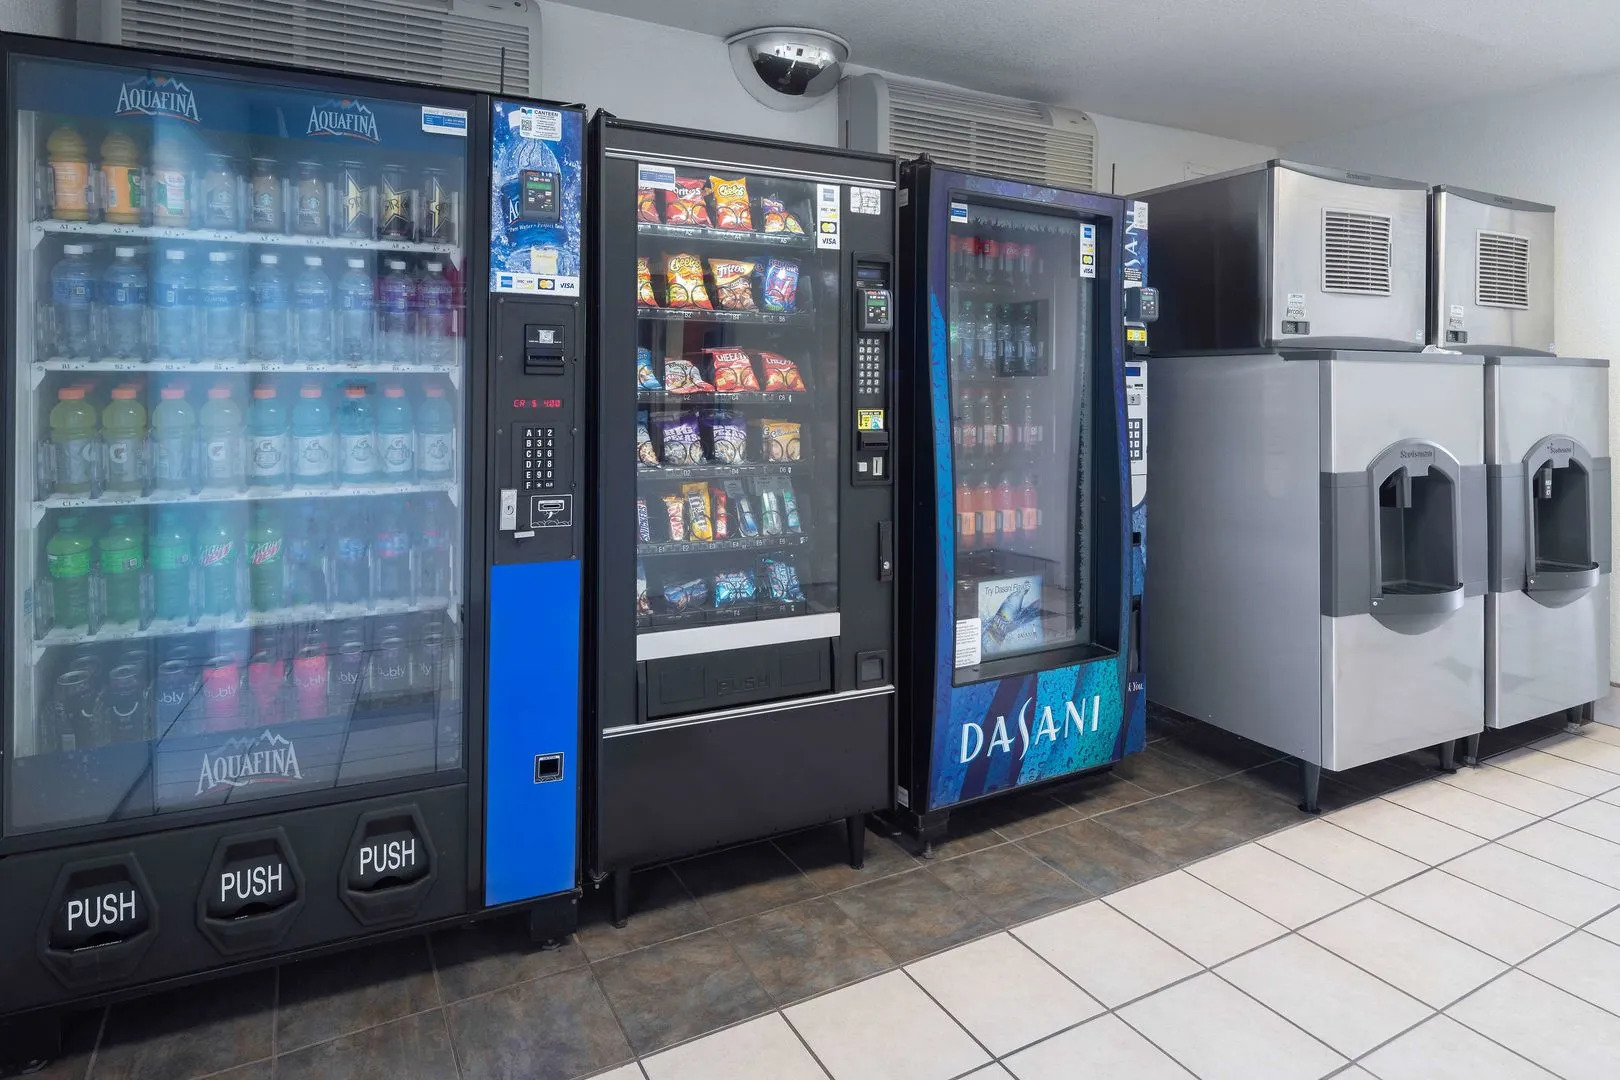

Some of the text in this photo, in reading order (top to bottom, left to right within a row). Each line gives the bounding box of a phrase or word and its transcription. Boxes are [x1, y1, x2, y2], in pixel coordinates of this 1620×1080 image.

[115, 82, 201, 122] AQUAFINA
[306, 105, 381, 142] AQUAFINA
[526, 450, 552, 458] C 5 6
[985, 586, 993, 597] Try
[960, 695, 1100, 764] DASANI
[195, 741, 303, 797] AQUAFINA
[359, 838, 415, 876] PUSH
[221, 863, 283, 903] PUSH
[67, 890, 136, 932] PUSH
